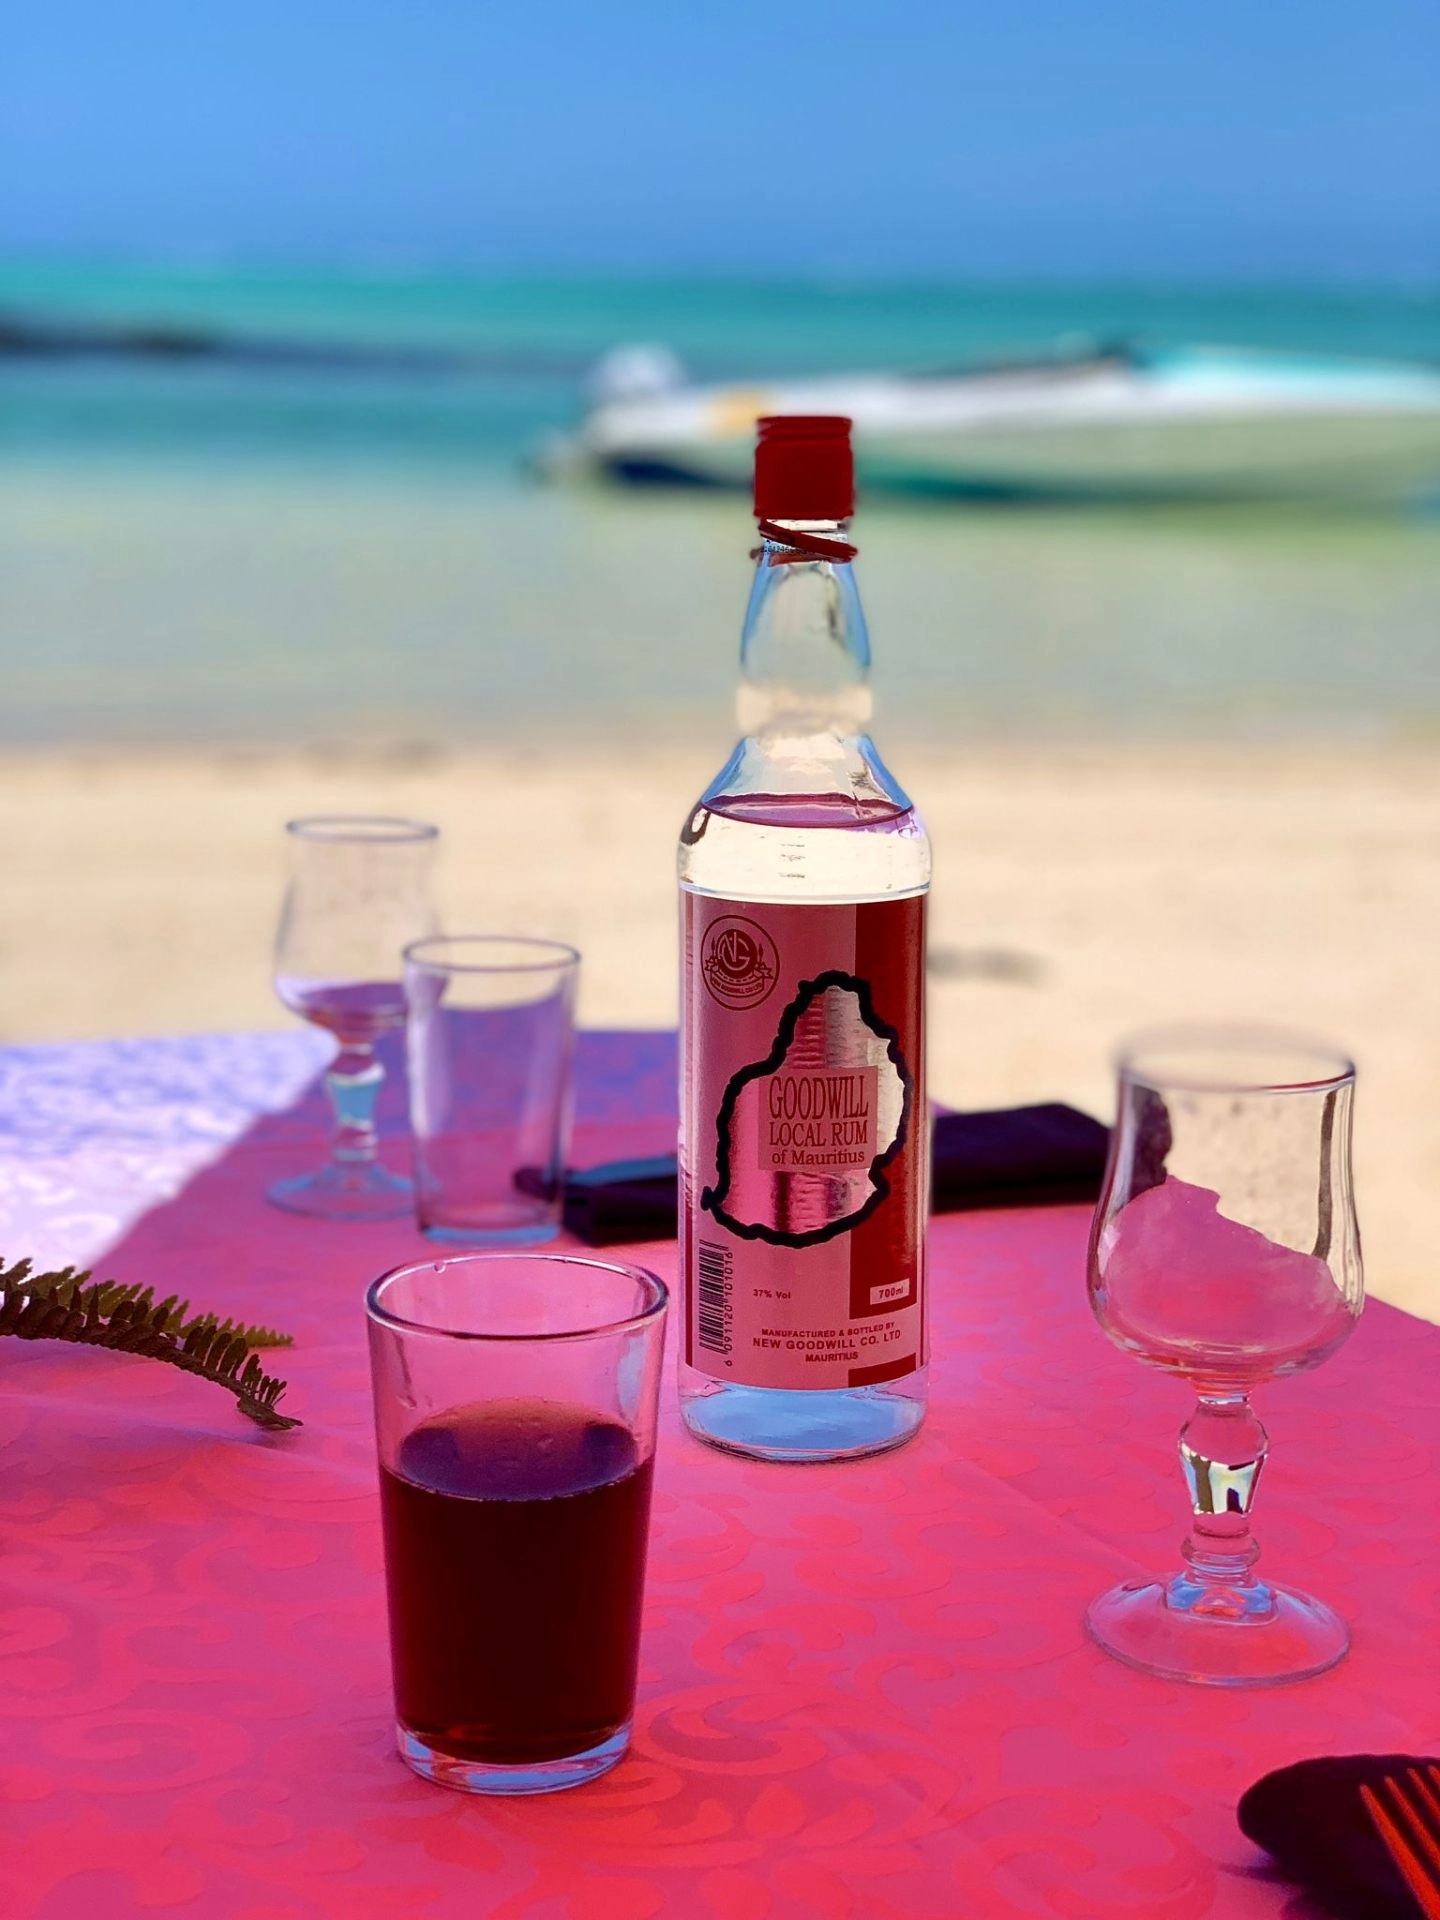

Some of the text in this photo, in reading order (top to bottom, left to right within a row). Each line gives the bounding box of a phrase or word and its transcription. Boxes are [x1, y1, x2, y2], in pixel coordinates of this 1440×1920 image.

[769, 1075, 869, 1120] GOODWILL
[769, 1120, 868, 1147] LOCAL RUM
[771, 1148, 865, 1165] of Mauritius
[753, 1289, 791, 1299] 37% Vol
[878, 1285, 904, 1299] 700ml
[761, 1328, 836, 1338] MANUFACTURED
[847, 1324, 884, 1336] BOTTLED
[885, 1321, 895, 1330] BY
[752, 1329, 901, 1350] NEW GOODWILL CO. LTD
[805, 1351, 859, 1362] MAURITIUS
